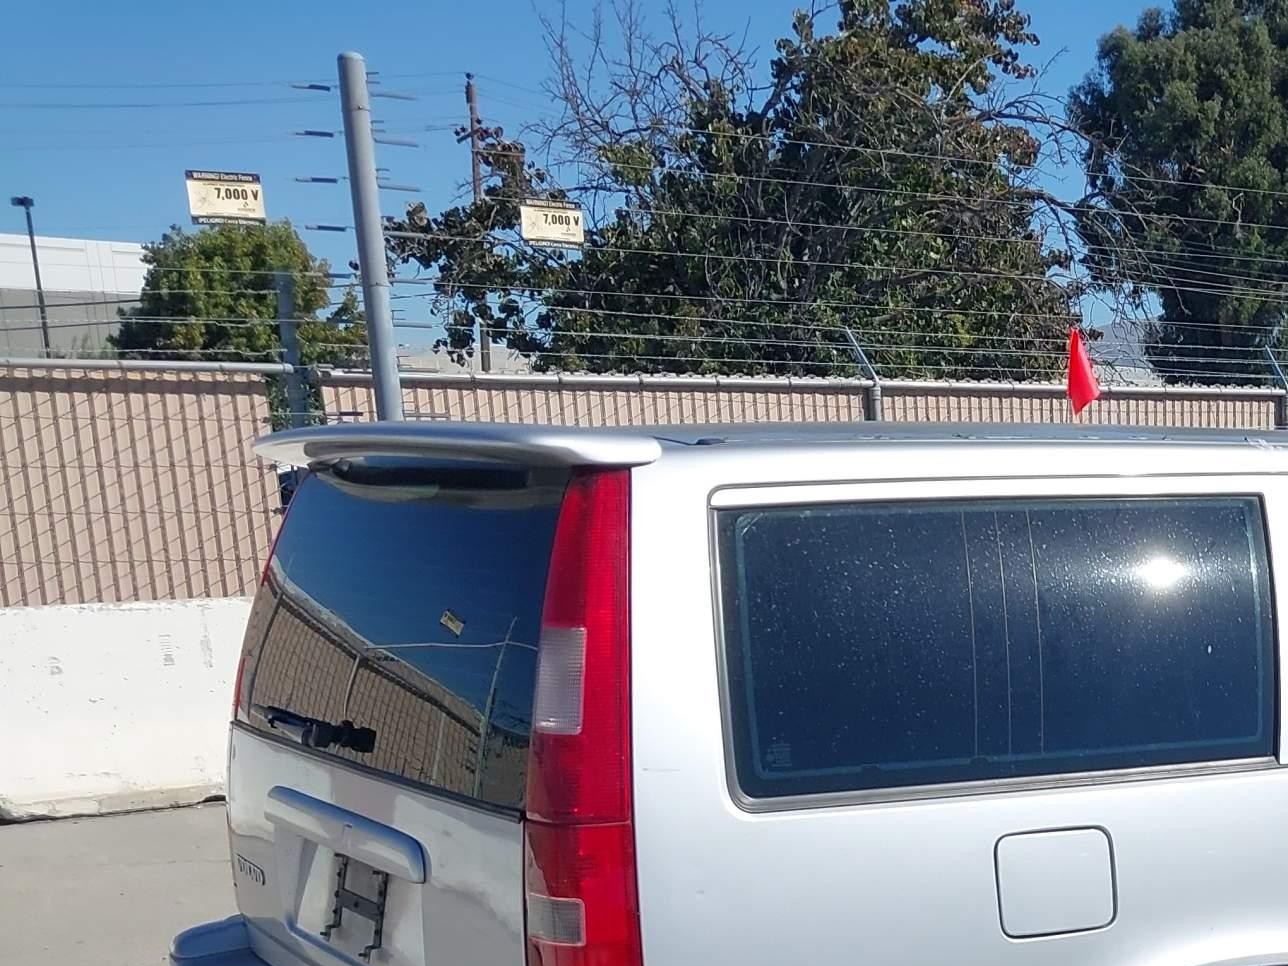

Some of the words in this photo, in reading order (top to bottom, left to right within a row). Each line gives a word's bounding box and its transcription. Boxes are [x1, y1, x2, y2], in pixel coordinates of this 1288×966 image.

[214, 187, 248, 201] 7,000
[251, 189, 259, 201] V
[542, 213, 571, 226] 7,000
[573, 215, 580, 226] V
